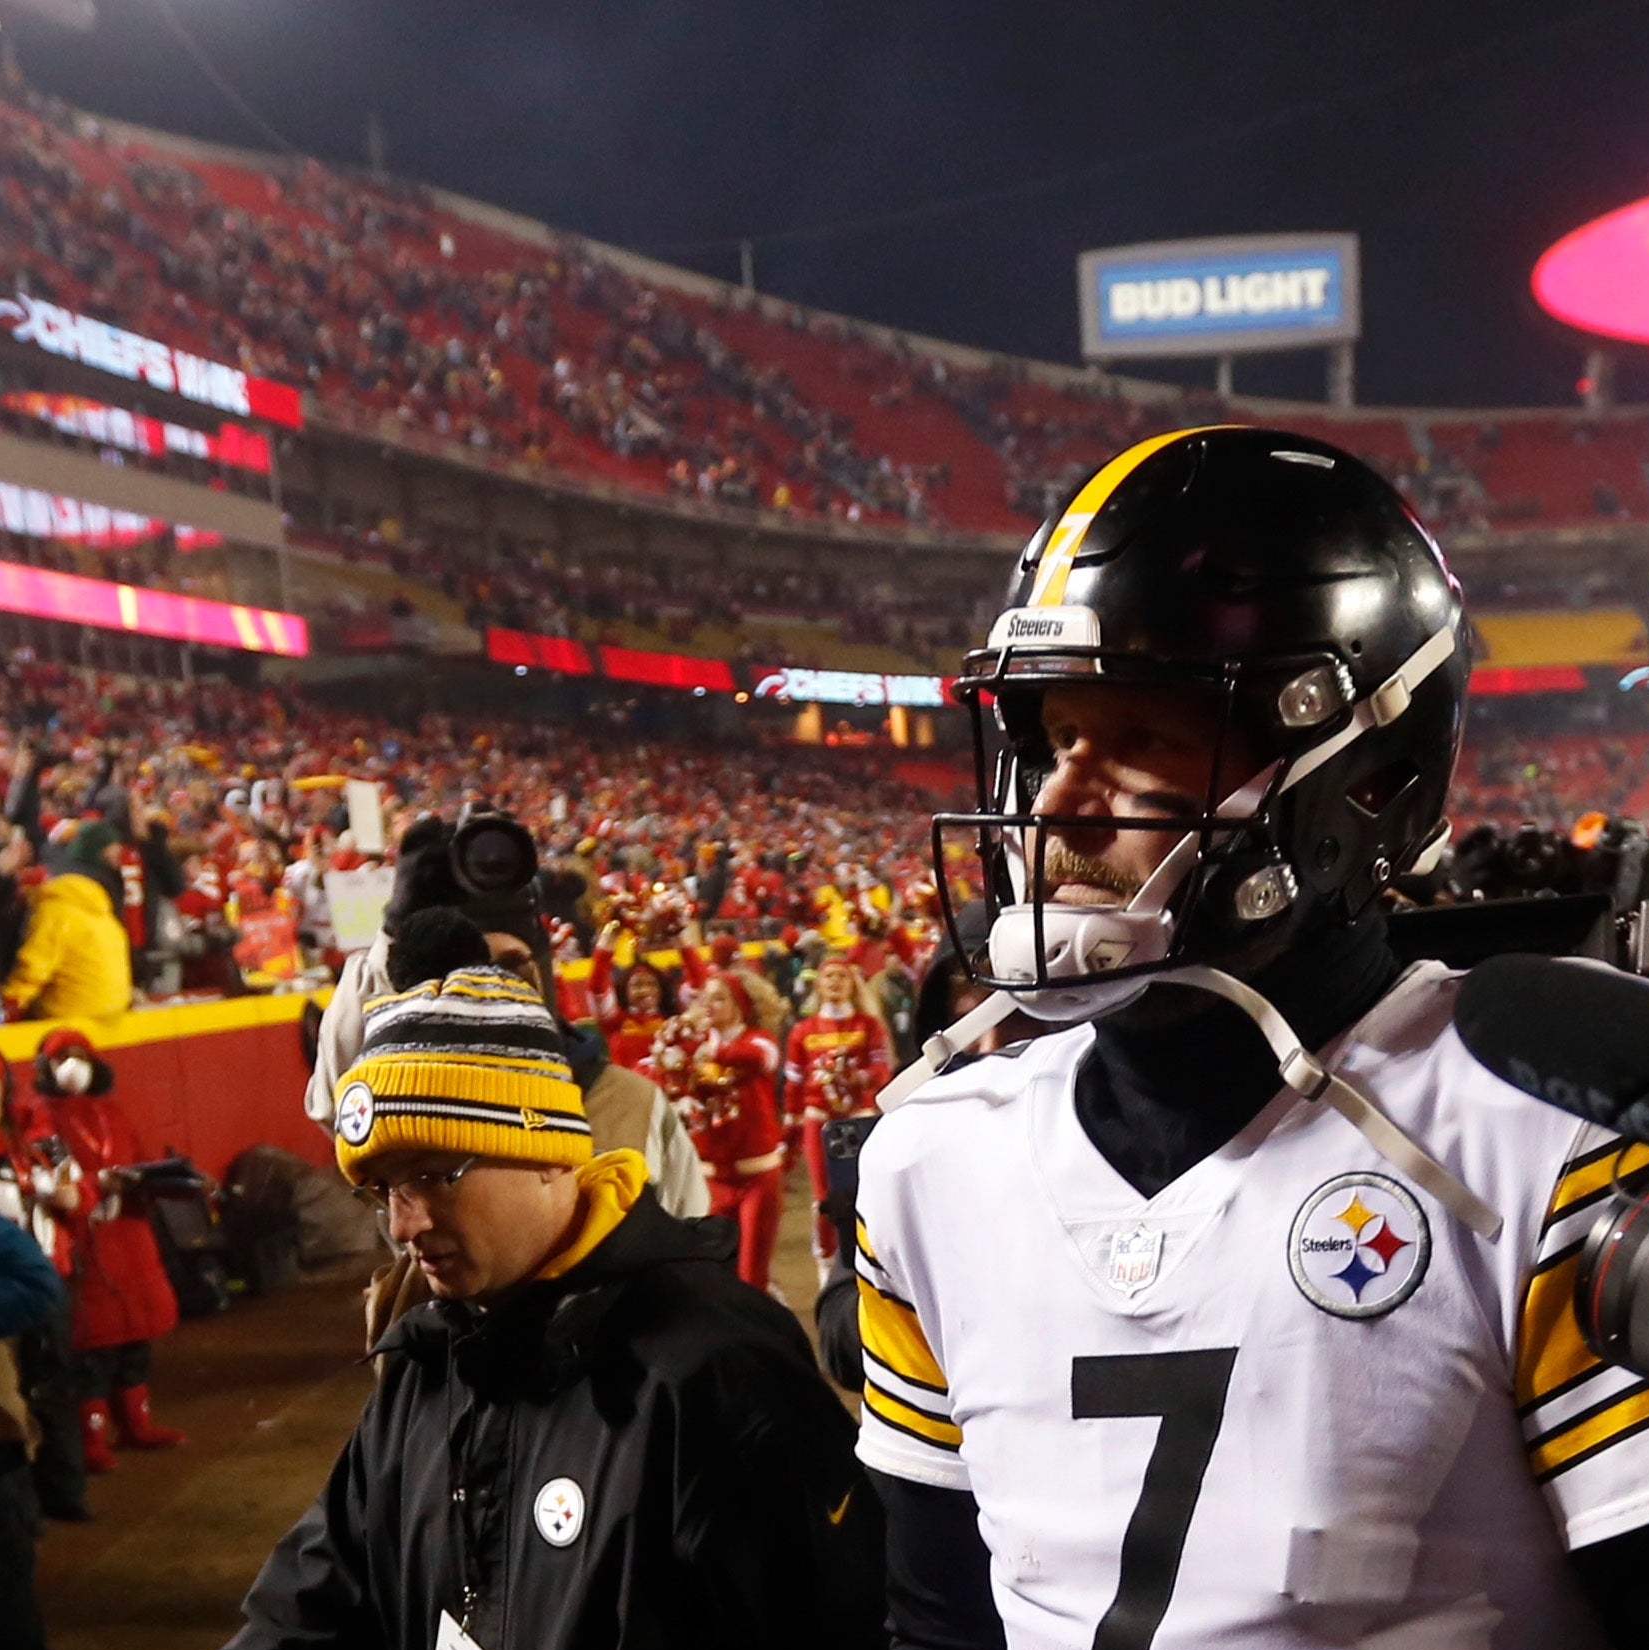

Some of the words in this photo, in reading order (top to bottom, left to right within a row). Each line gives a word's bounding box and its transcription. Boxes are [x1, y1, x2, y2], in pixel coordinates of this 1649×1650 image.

[1108, 277, 1201, 323] BUD
[1203, 268, 1327, 318] LIGHT
[29, 298, 175, 392] CHIEFS
[1007, 611, 1065, 638] Steelers
[1302, 1237, 1353, 1254] Steelers
